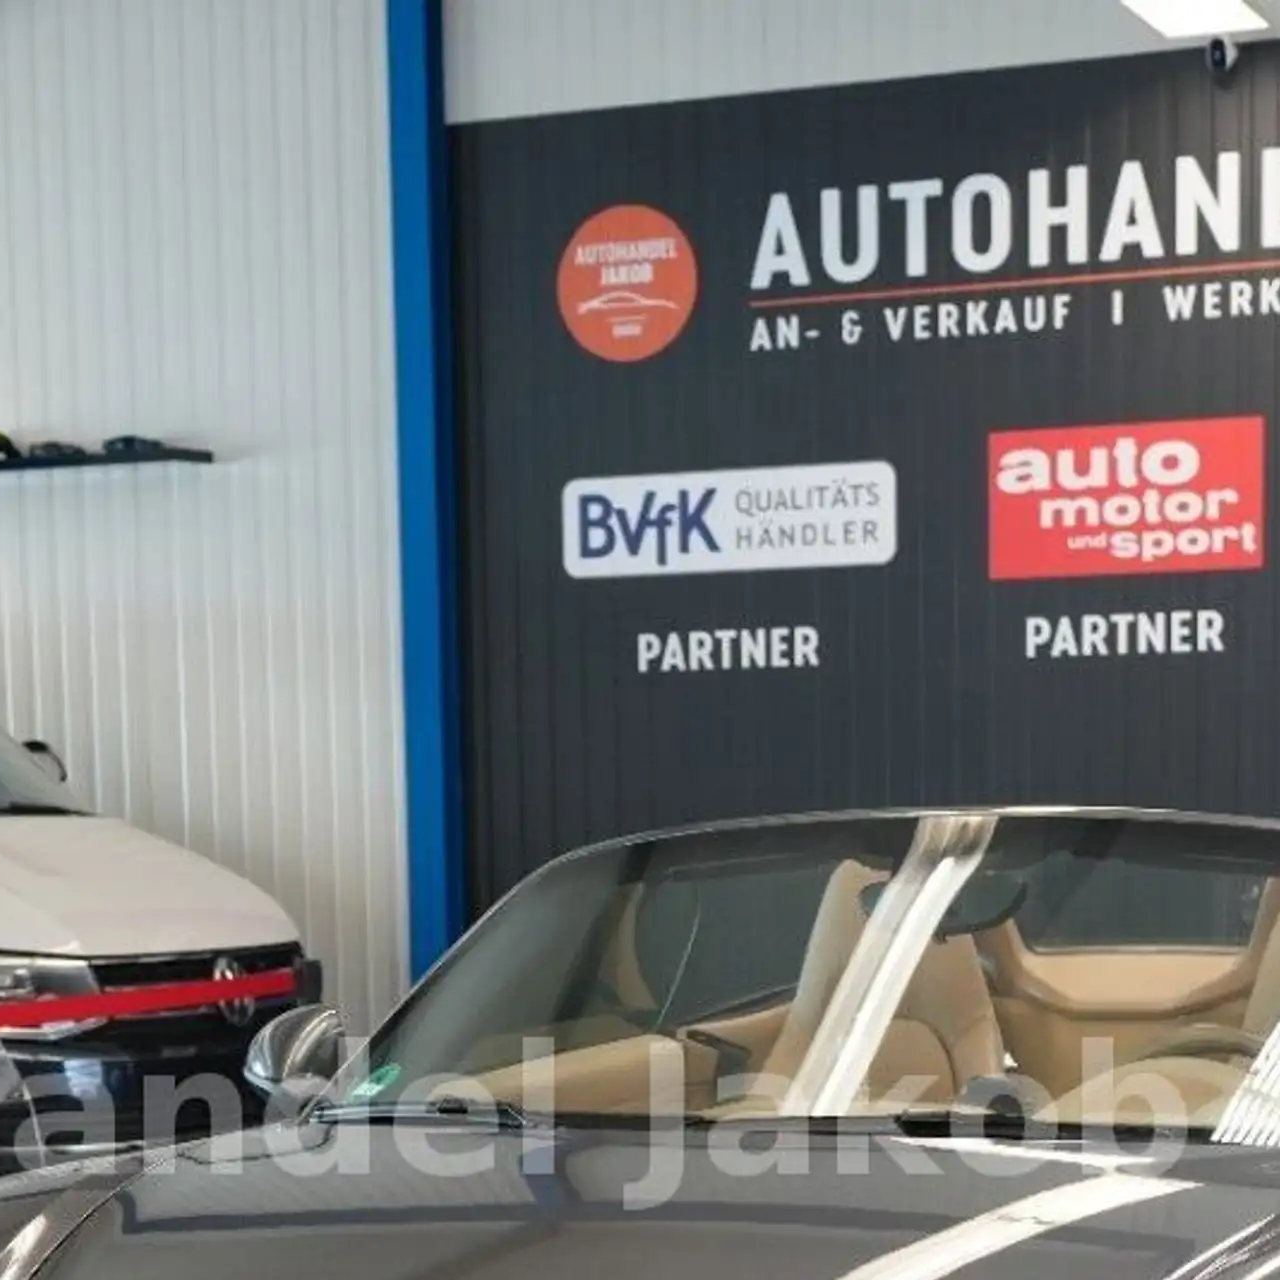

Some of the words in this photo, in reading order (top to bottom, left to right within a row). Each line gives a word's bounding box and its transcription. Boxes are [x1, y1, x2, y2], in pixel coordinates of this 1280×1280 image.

[750, 314, 820, 352] AN-
[842, 310, 862, 344] &
[885, 294, 1071, 341] VERKAUF
[996, 438, 1201, 493] auto
[734, 478, 881, 518] QUALITÄTS
[1038, 487, 1239, 530] motor
[578, 487, 721, 566] BVfK
[735, 515, 879, 550] HÄNDLER
[1067, 532, 1108, 550] und
[1109, 521, 1258, 563] sport
[637, 626, 820, 672] PARTNER
[1025, 610, 1225, 658] PARTNER
